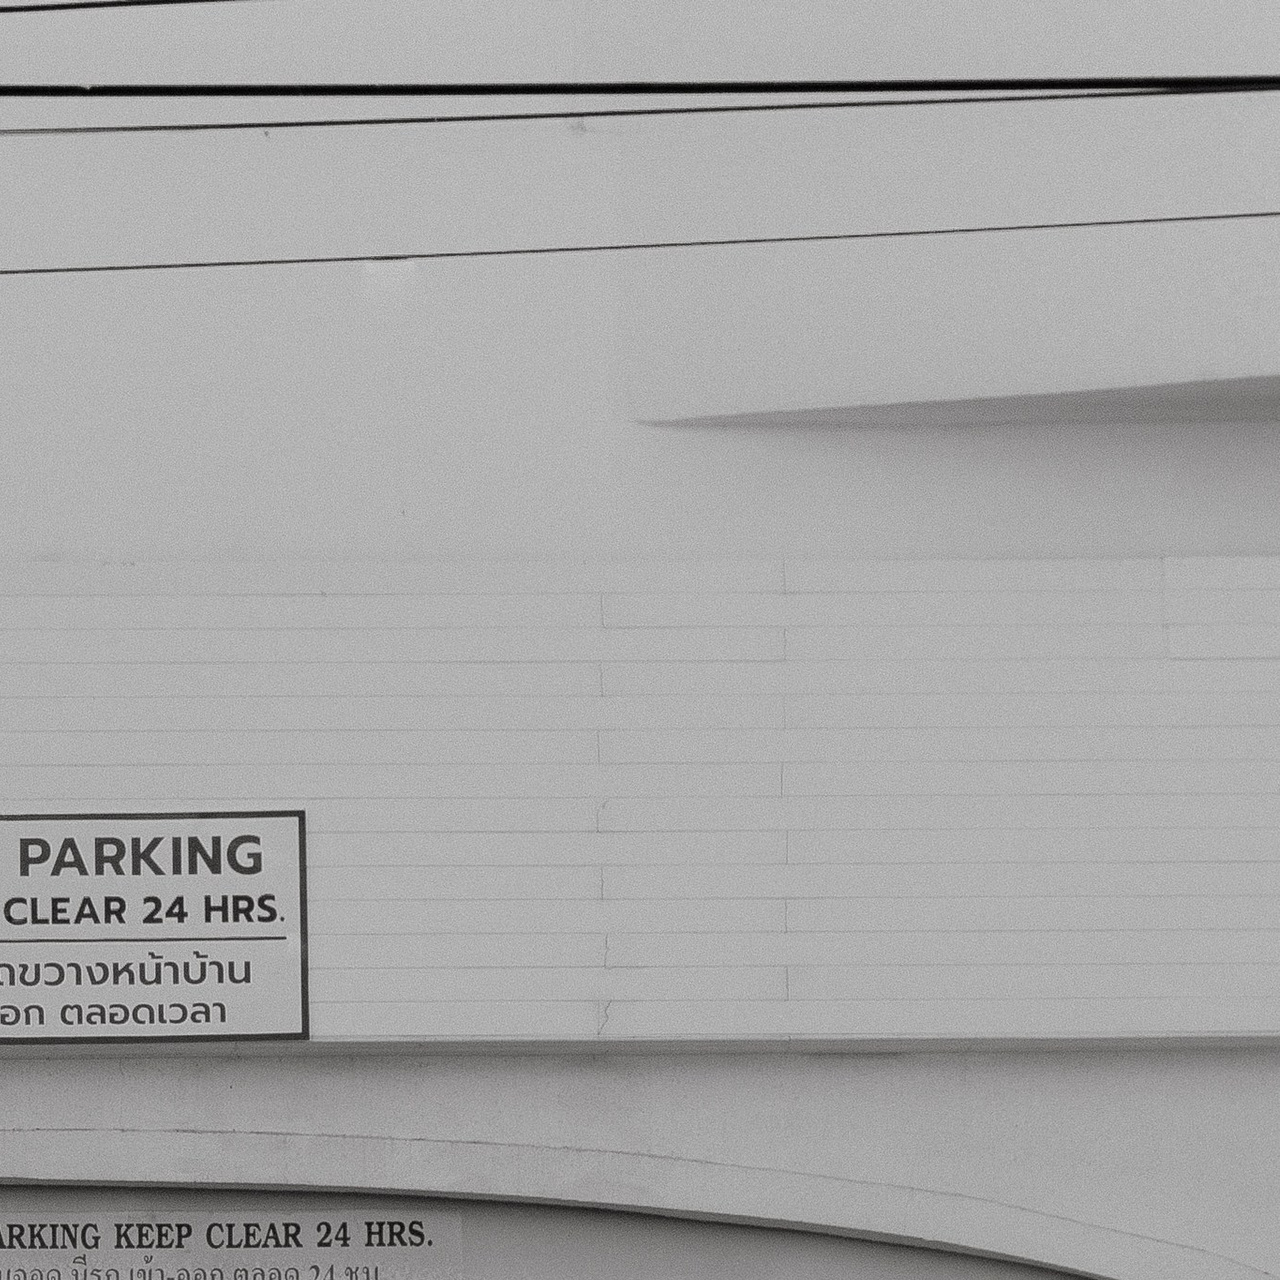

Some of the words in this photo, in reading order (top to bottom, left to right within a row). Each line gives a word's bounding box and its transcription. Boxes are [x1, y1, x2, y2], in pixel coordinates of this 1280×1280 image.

[19, 834, 263, 877] PARKING
[3, 895, 126, 926] CLEAR
[142, 894, 188, 924] 24
[204, 893, 285, 924] HRS.
[60, 1001, 227, 1026] ตลอดเวลา
[114, 1223, 193, 1250] KEEP
[206, 1222, 303, 1250] CLEAR
[316, 1221, 351, 1248] 24
[364, 1220, 433, 1248] HRS.
